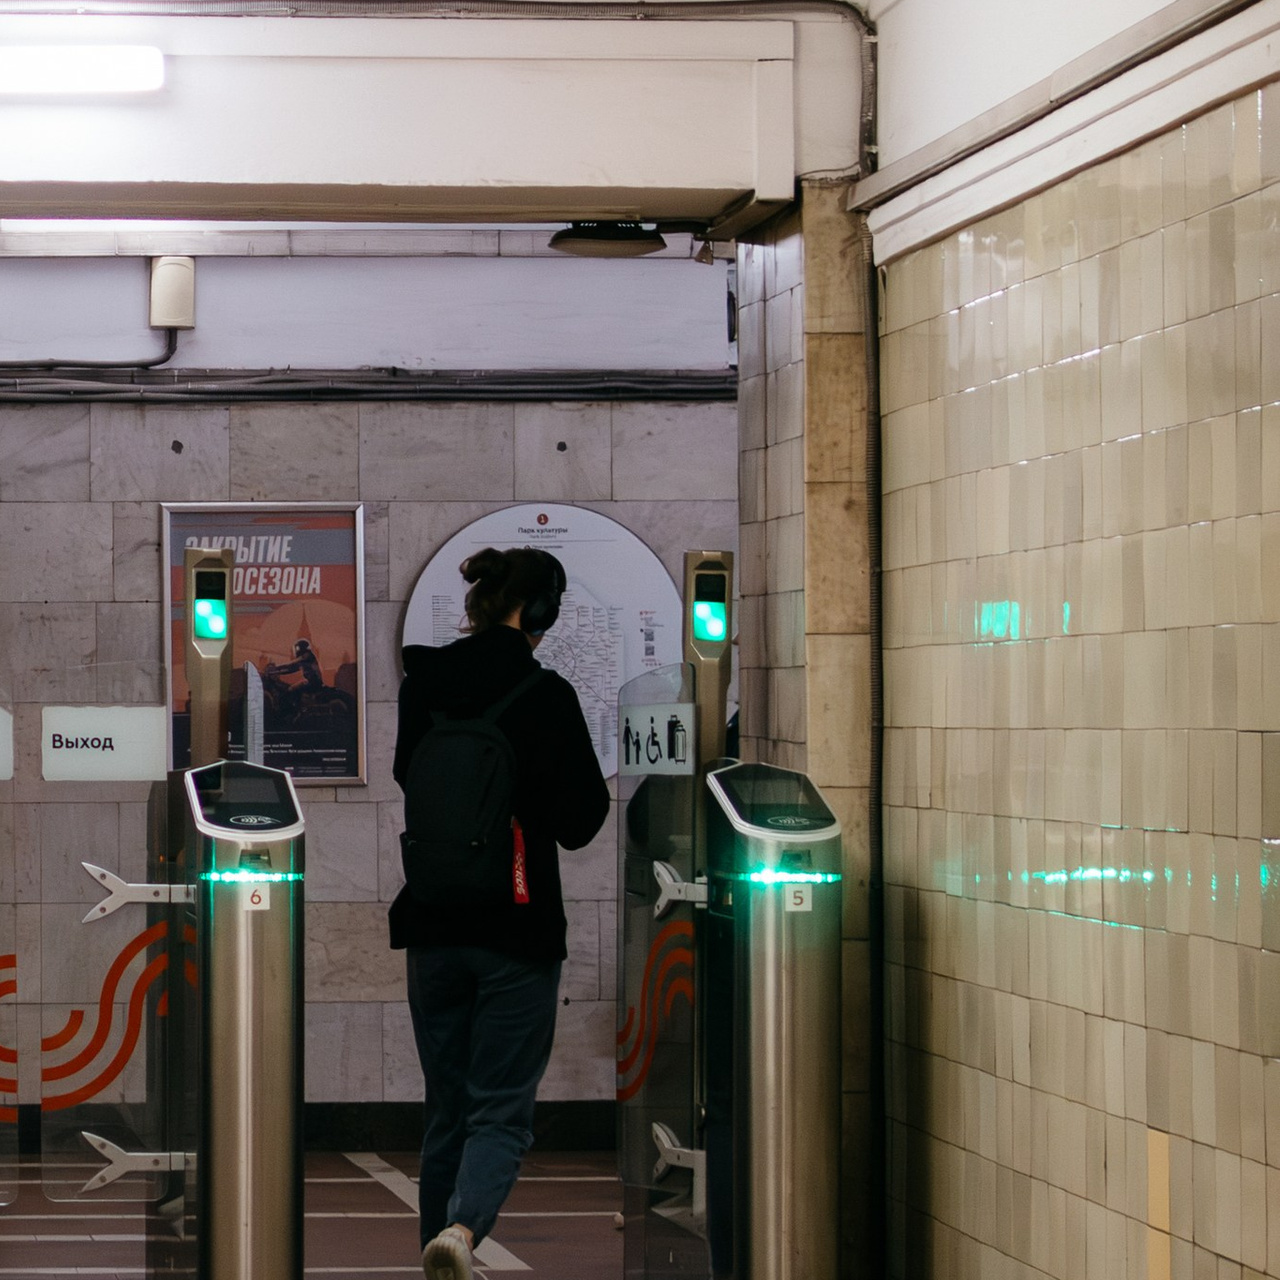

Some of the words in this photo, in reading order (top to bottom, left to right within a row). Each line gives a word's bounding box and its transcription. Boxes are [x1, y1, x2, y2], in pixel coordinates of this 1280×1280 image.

[233, 566, 321, 595] ОСЕЗОНА
[52, 733, 114, 752] Выход
[250, 888, 262, 905] 6
[792, 890, 804, 906] 5
